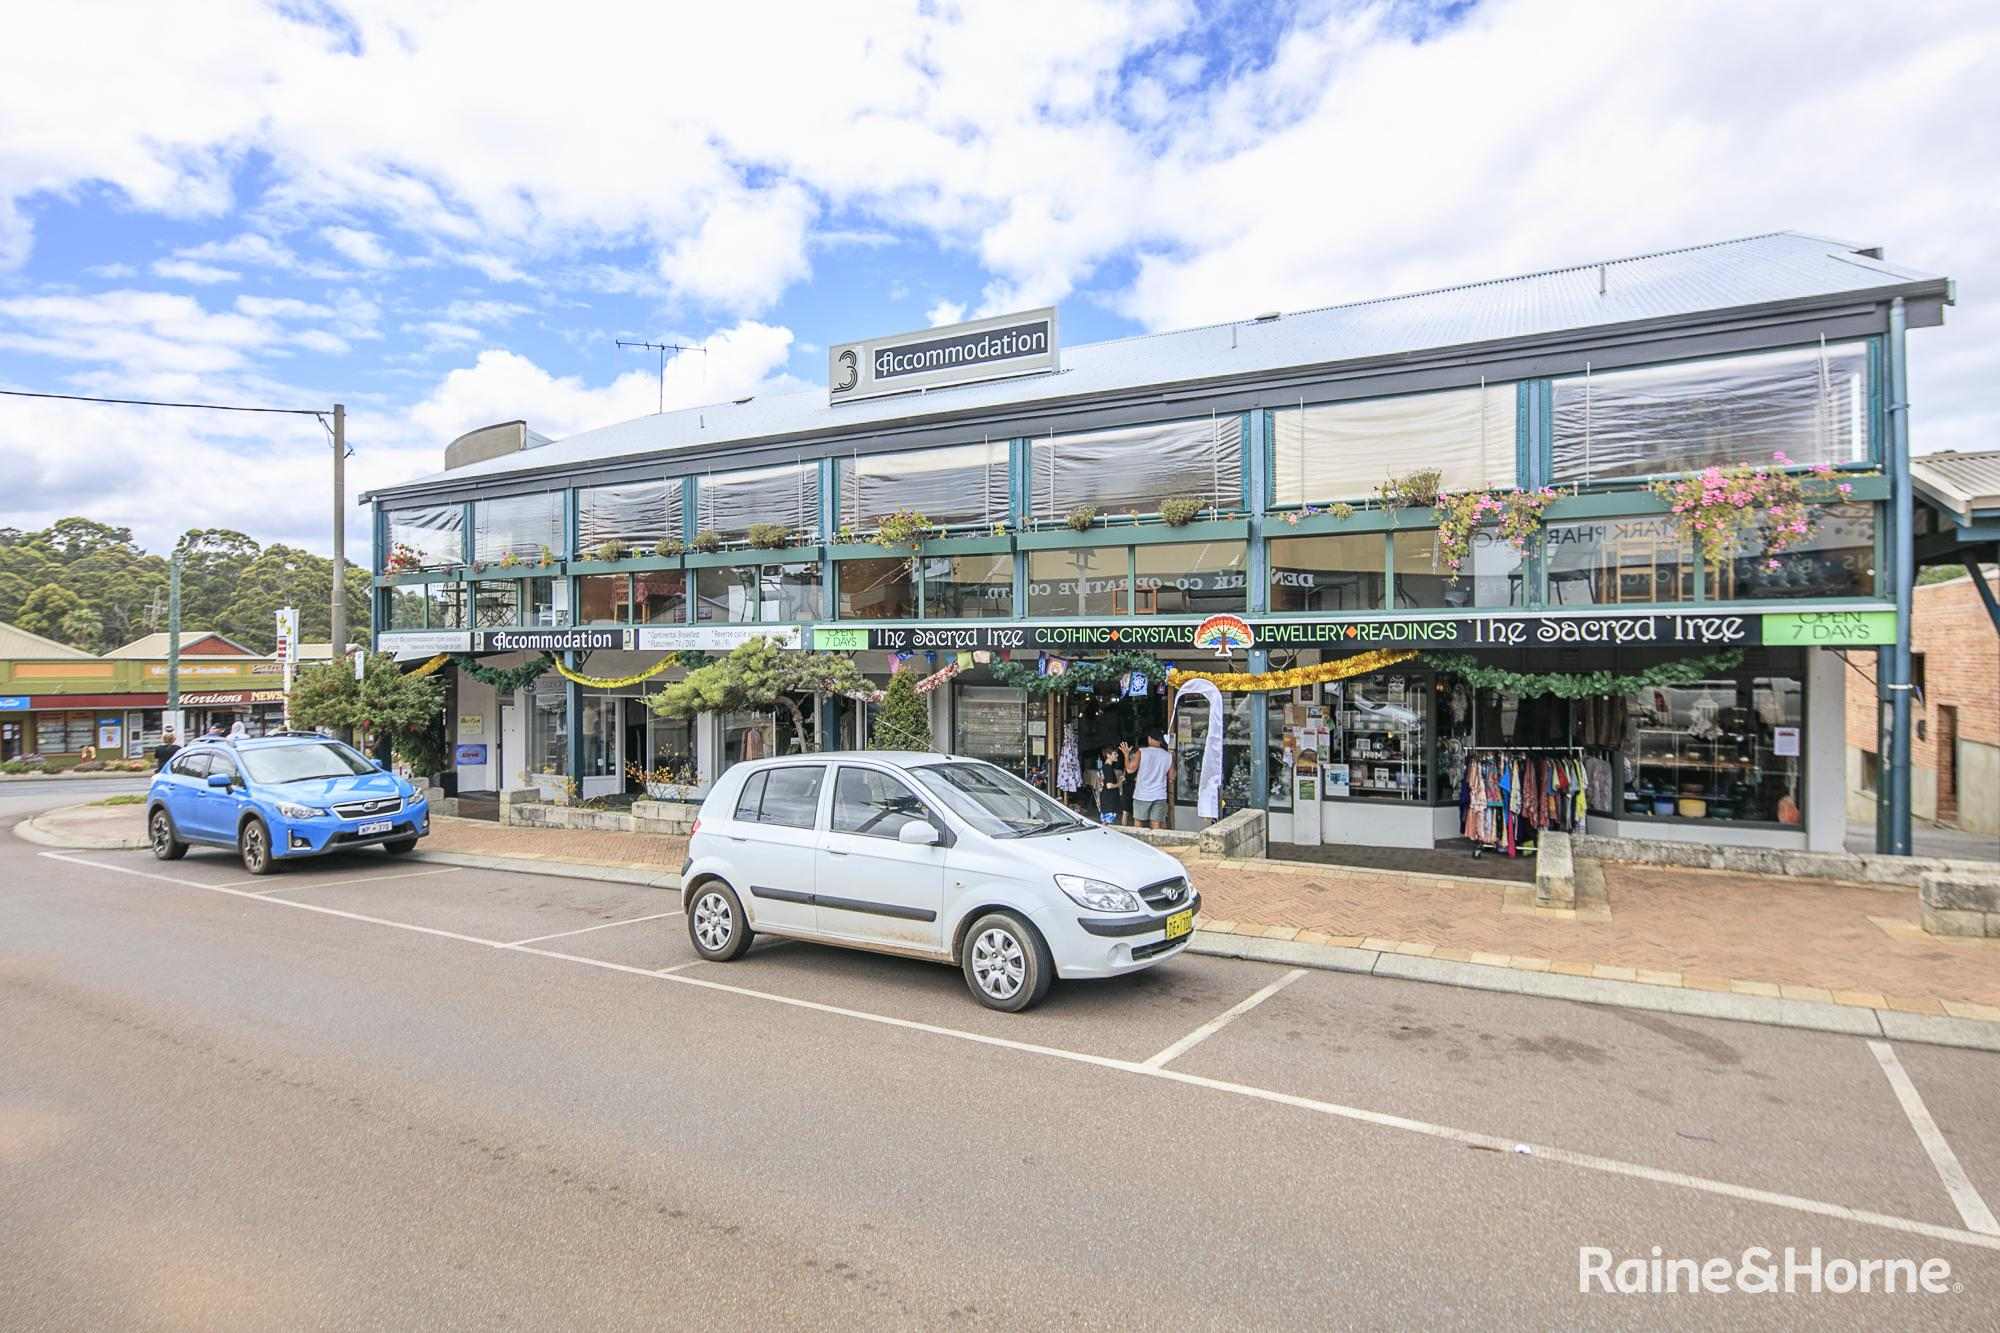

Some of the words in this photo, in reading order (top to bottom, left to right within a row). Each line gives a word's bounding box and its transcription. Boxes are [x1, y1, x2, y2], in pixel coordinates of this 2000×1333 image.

[876, 330, 1046, 377] Accommodation
[493, 631, 612, 650] Accommodation
[872, 628, 906, 648] The
[913, 627, 978, 648] Sacred
[983, 627, 1024, 648] Tree
[1035, 626, 1109, 644] CLOTHING
[1119, 625, 1193, 643] CRYSTALS
[1255, 624, 1347, 642] JEWELLERY
[1356, 621, 1457, 640] READINGS
[1468, 618, 1526, 643] The
[1536, 617, 1658, 643] Sacred
[1665, 615, 1744, 642] Tree
[1791, 625, 1803, 639] 7
[1813, 624, 1870, 640] DAYS
[825, 637, 830, 647] 7
[833, 637, 857, 647] DAYS
